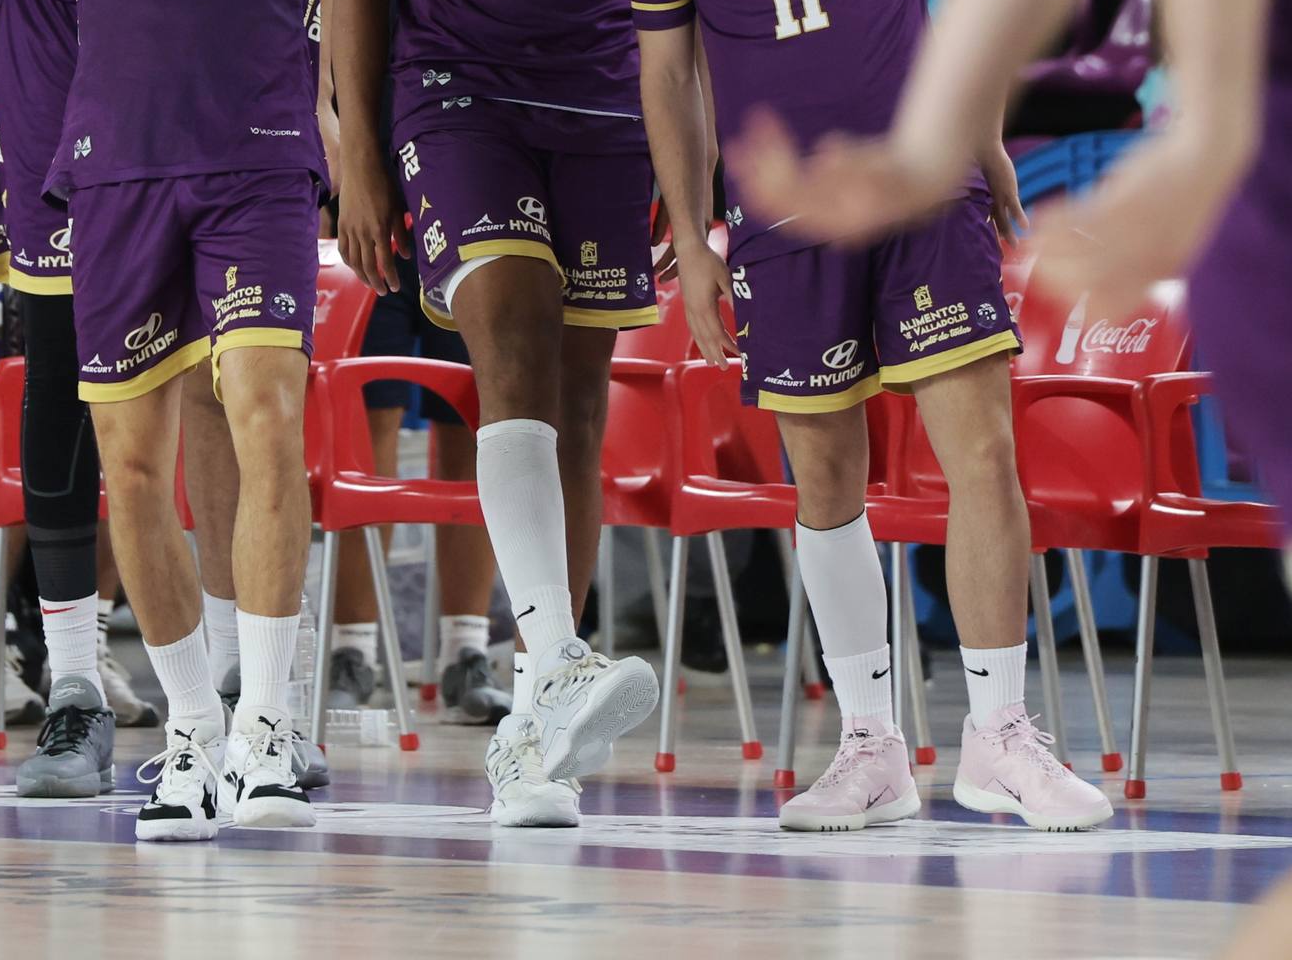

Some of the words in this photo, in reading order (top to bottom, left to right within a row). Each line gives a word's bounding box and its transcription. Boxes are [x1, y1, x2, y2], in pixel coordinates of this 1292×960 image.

[461, 223, 506, 236] MERCURY
[566, 267, 627, 280] LIMENTOS
[899, 302, 966, 334] ALIMENTOS
[913, 312, 969, 336] VALLADOLID
[116, 328, 178, 373] HYUNDAI
[764, 376, 806, 387] MERCURY
